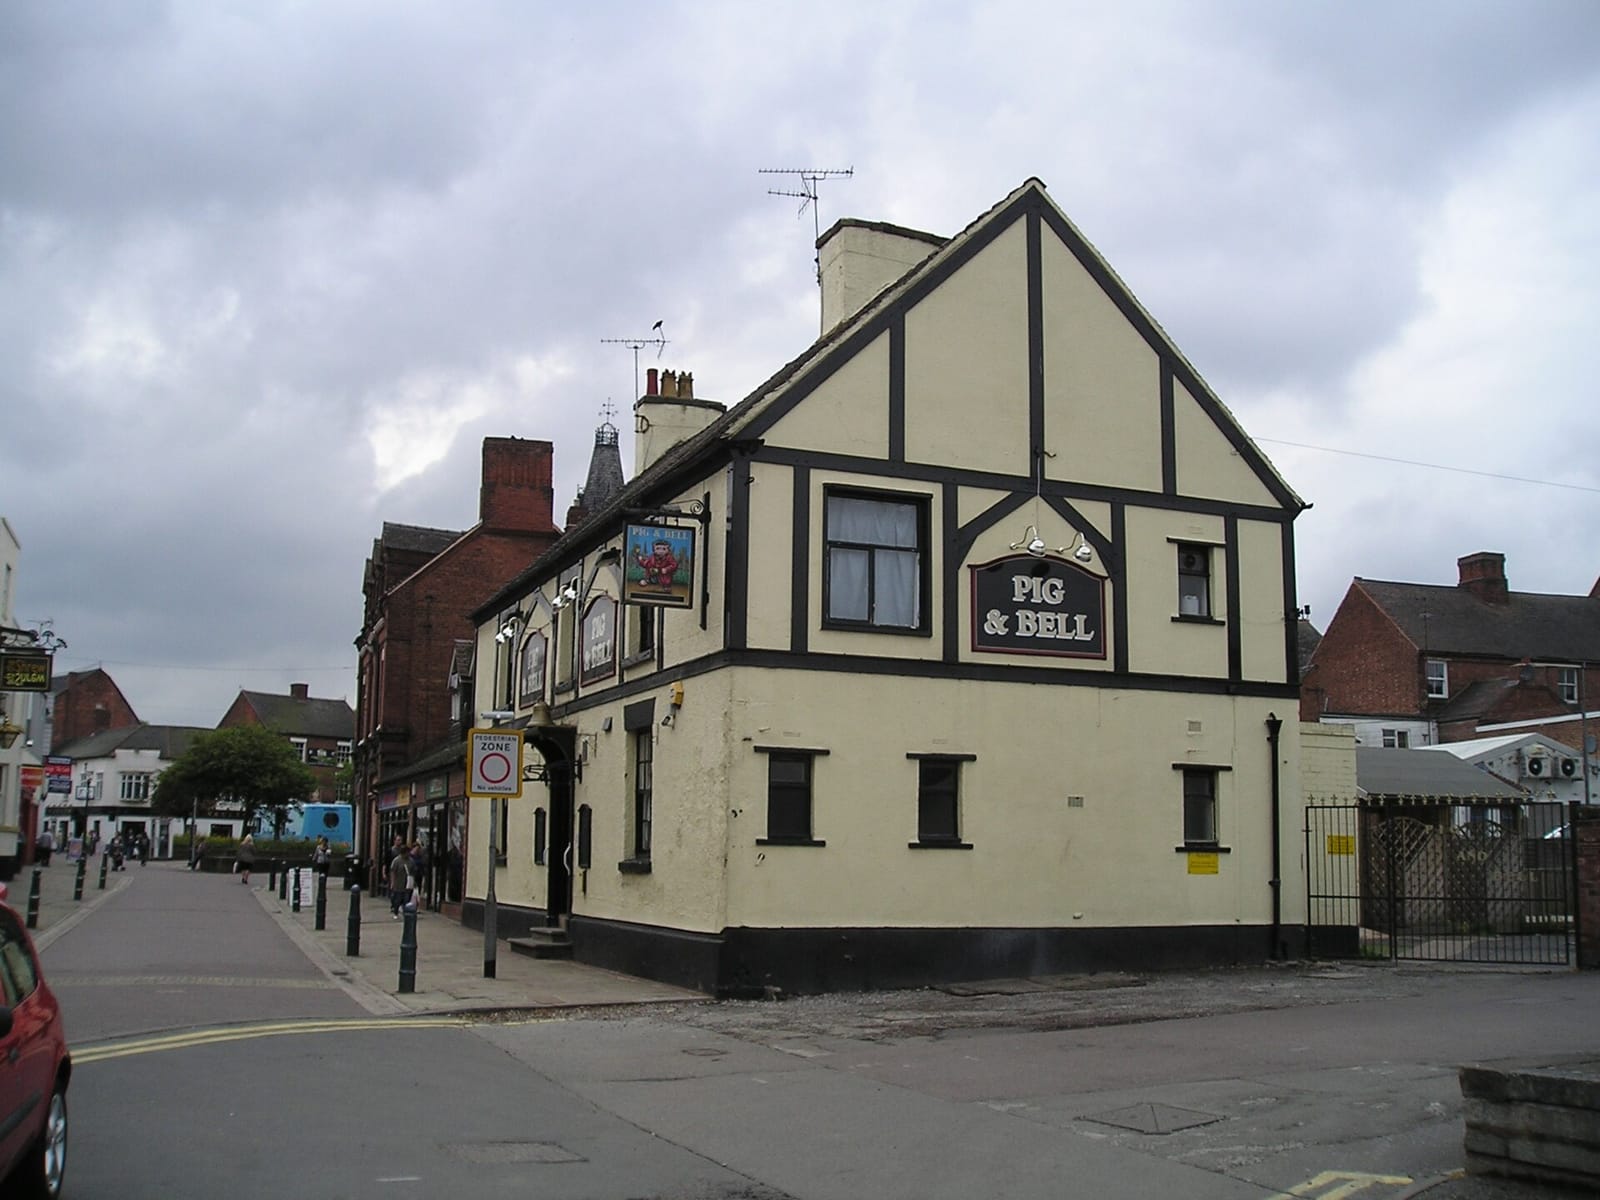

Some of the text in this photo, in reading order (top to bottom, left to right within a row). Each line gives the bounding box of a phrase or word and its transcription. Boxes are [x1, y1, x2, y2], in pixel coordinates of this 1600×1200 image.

[632, 528, 648, 537] PIG
[665, 530, 689, 539] BELL
[1012, 575, 1066, 604] PIG
[591, 612, 606, 640] PIG
[984, 609, 1095, 640] & BELL
[591, 639, 612, 669] BELL
[481, 742, 511, 751] ZONE
[1457, 850, 1488, 861] AND
